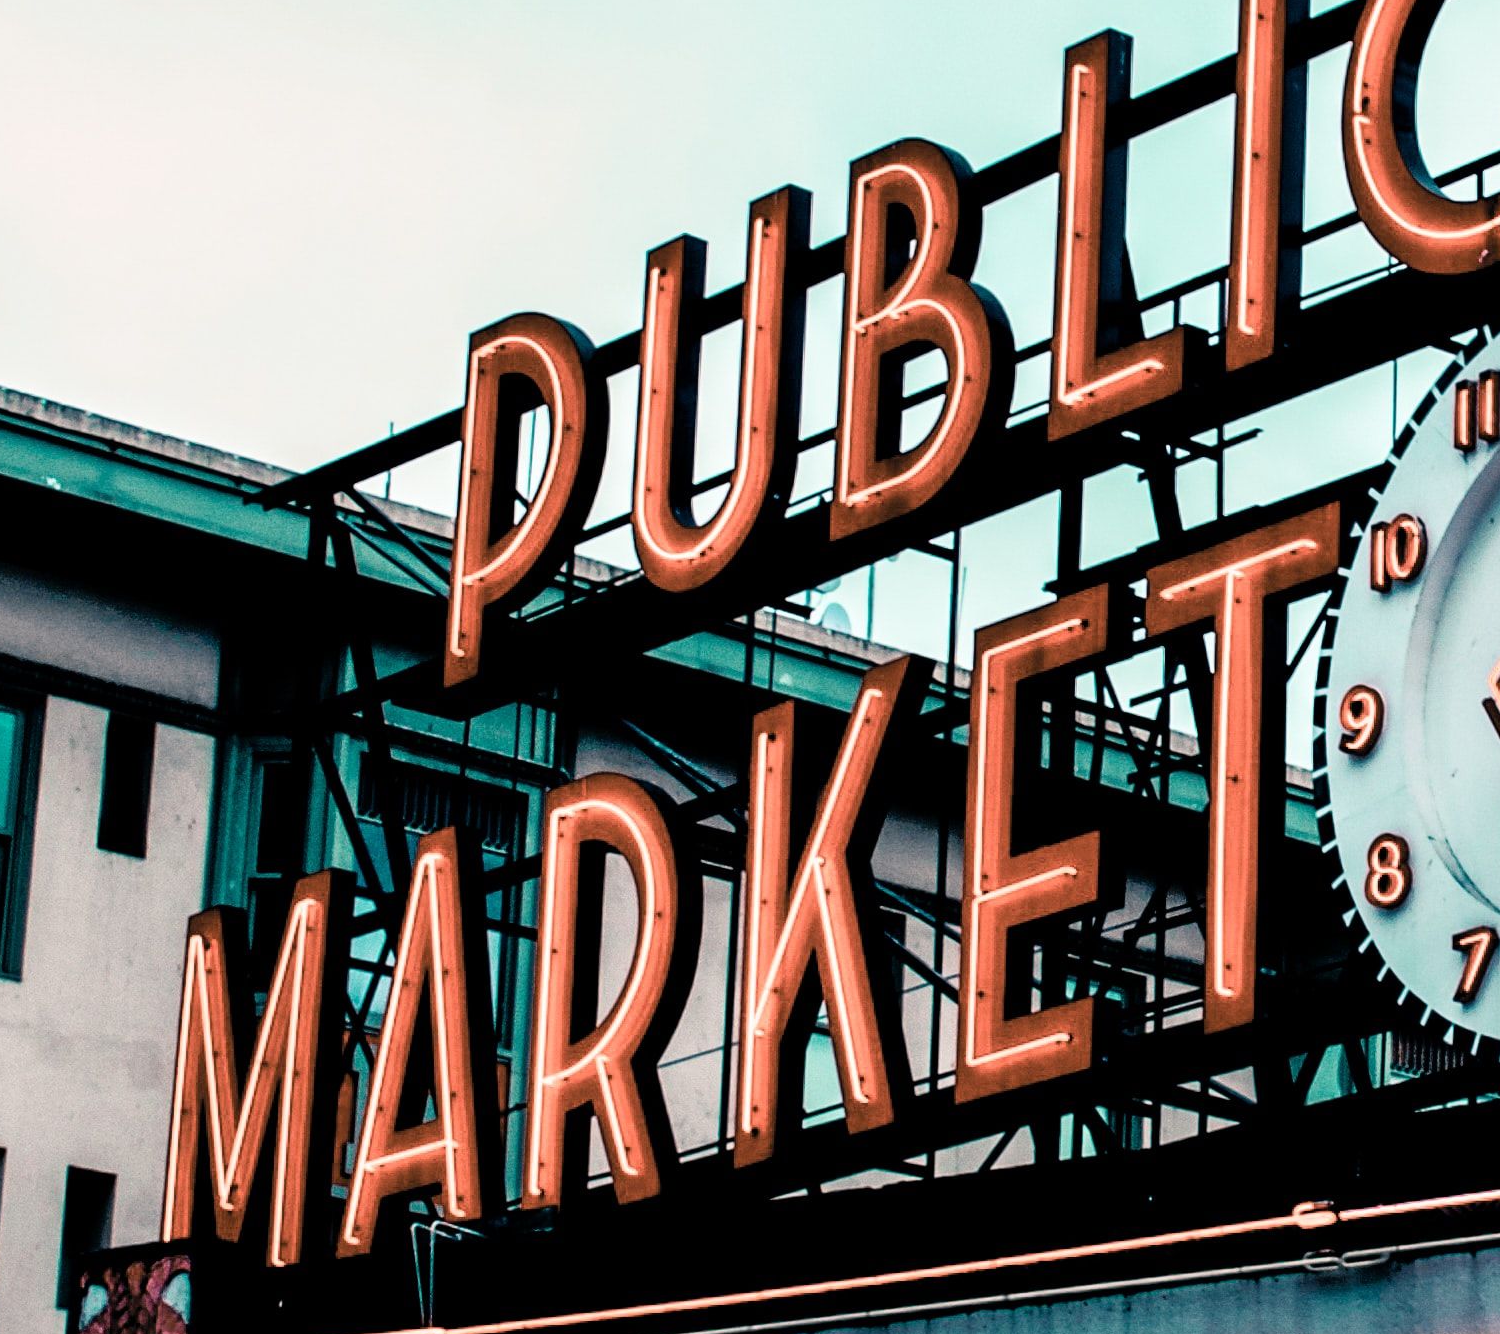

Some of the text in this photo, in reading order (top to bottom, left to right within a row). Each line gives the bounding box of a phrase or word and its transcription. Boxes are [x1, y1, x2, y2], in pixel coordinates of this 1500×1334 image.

[1370, 513, 1428, 592] 10
[1338, 684, 1386, 758] 9
[162, 501, 1346, 1269] MARKET
[1364, 832, 1412, 910] 8
[1452, 926, 1500, 1004] 7
